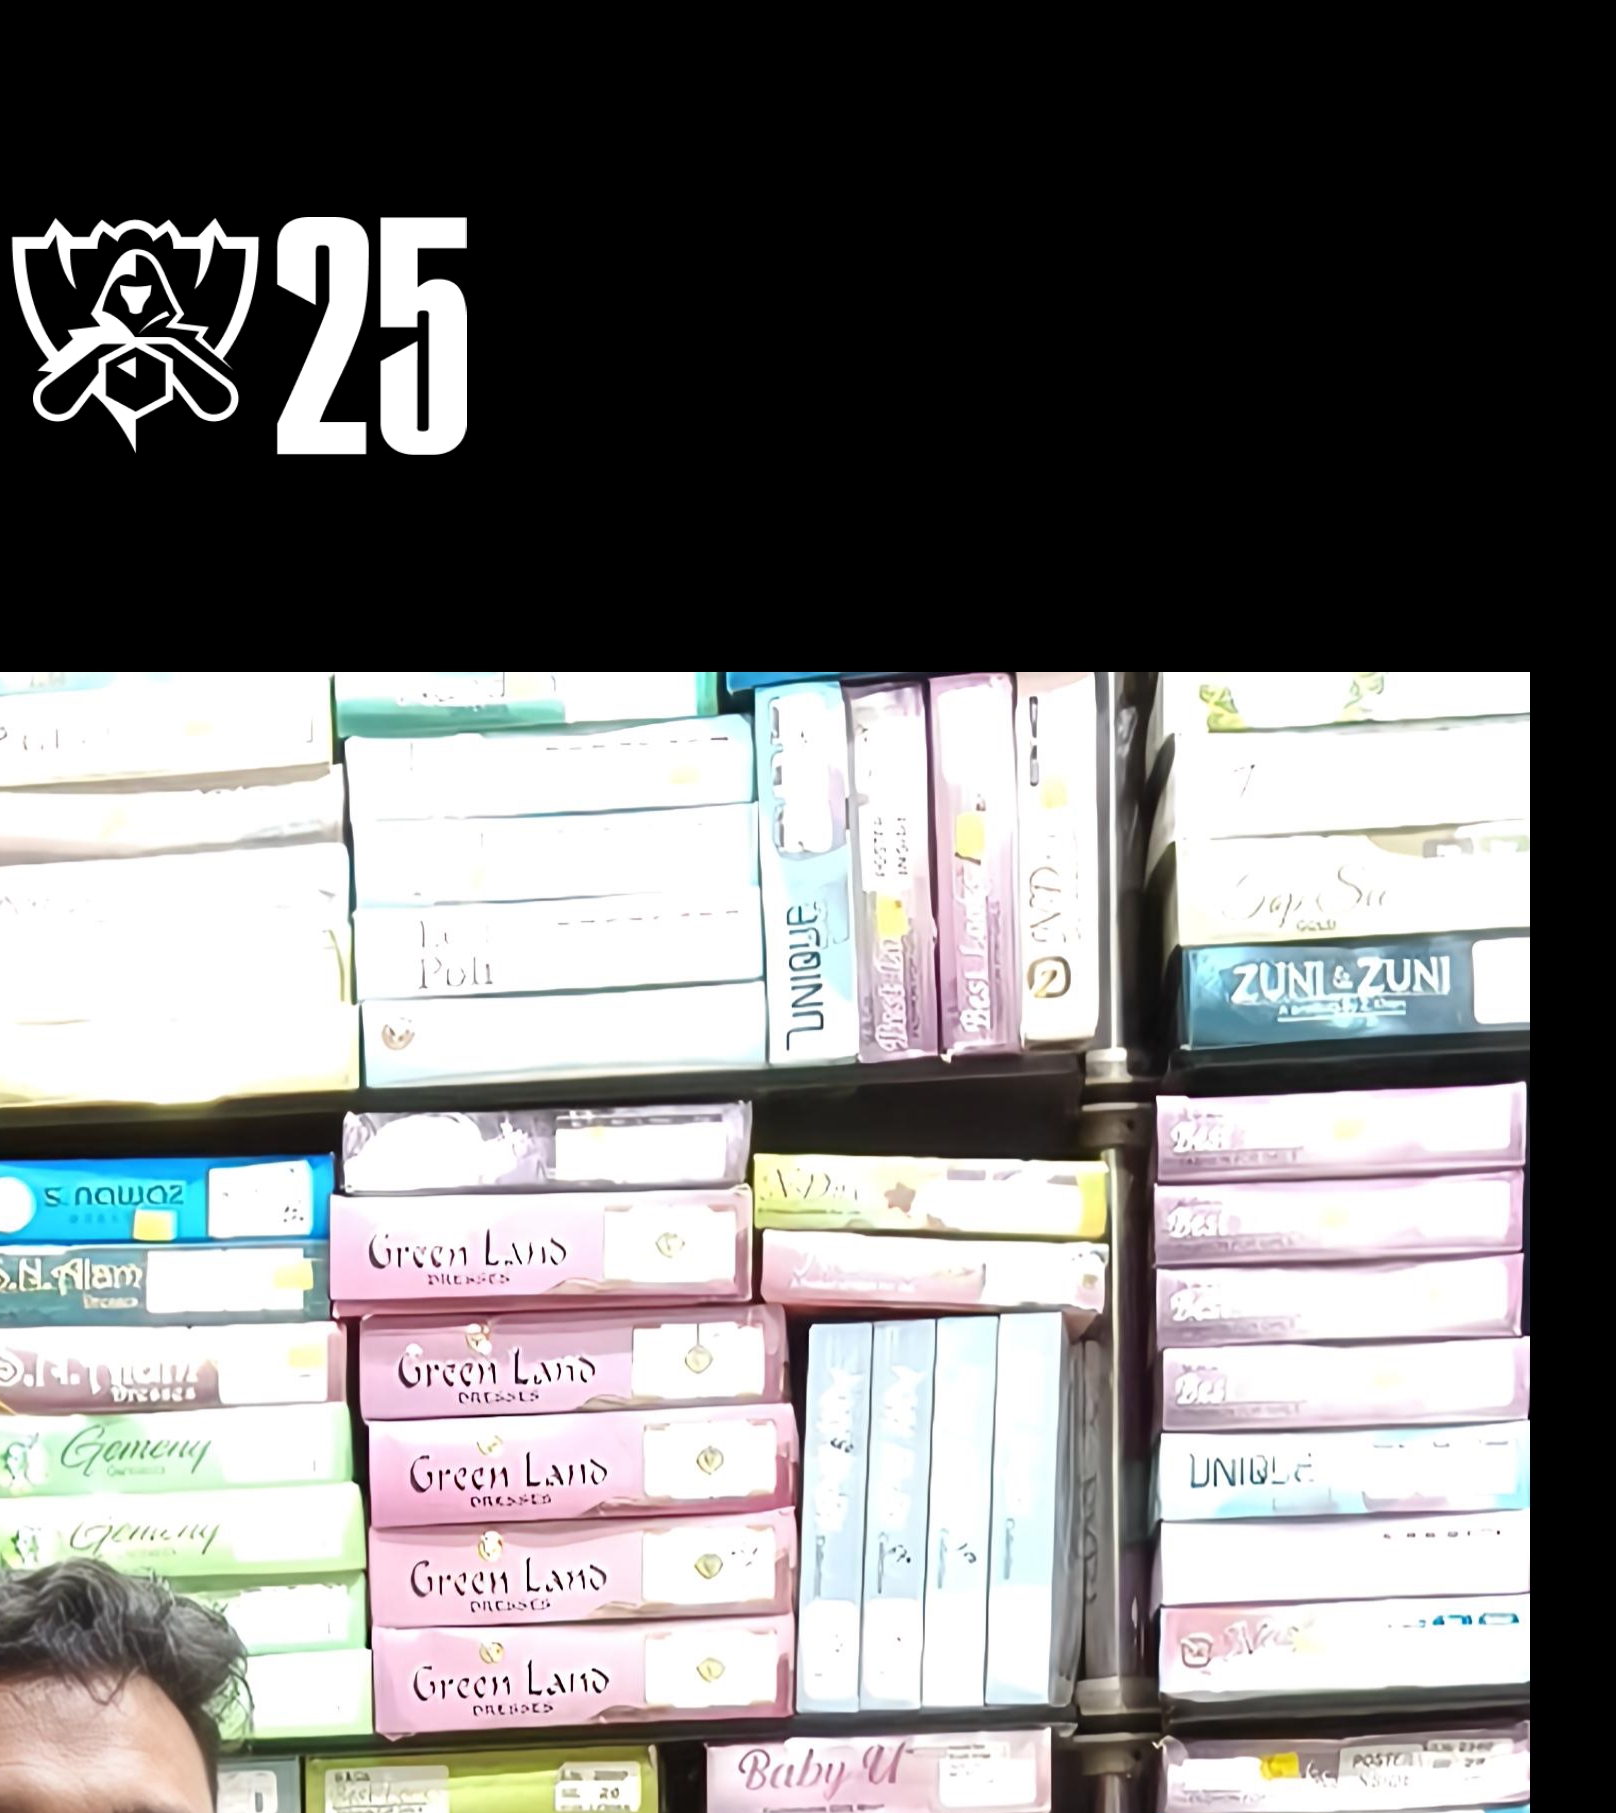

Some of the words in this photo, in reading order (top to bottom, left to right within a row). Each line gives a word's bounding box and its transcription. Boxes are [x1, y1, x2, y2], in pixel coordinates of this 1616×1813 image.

[786, 902, 825, 1051] UNIQUE
[1230, 962, 1325, 1003] ZUNI
[1357, 956, 1450, 995] ZUNI
[368, 1233, 469, 1272] Green
[397, 1350, 498, 1390] Green
[408, 1455, 509, 1495] Green
[410, 1559, 510, 1599] Green
[412, 1665, 511, 1703] Green
[738, 1744, 849, 1802] Baby
[861, 1739, 906, 1785] U
